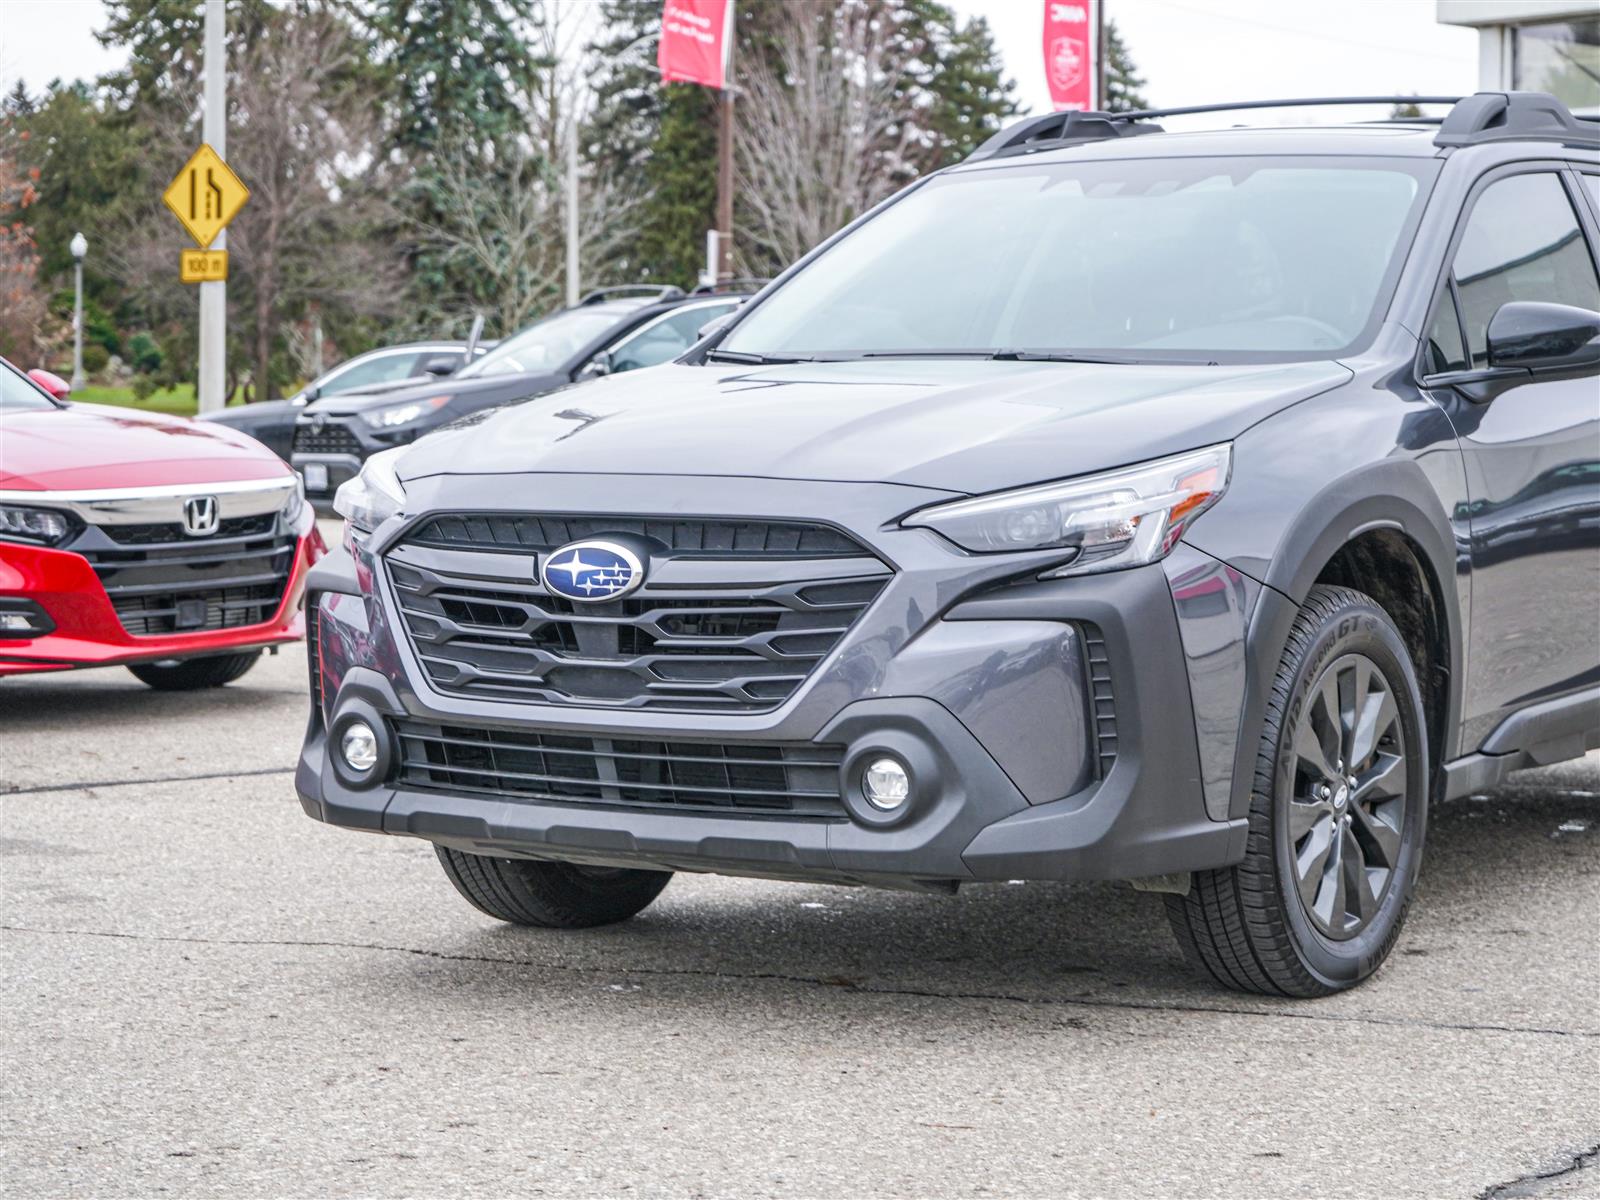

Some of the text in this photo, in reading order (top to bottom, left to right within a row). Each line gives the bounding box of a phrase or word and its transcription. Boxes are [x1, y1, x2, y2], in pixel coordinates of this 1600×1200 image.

[1279, 615, 1361, 779] AVID Ascend GT
[1365, 895, 1410, 971] YOKOHAMA
